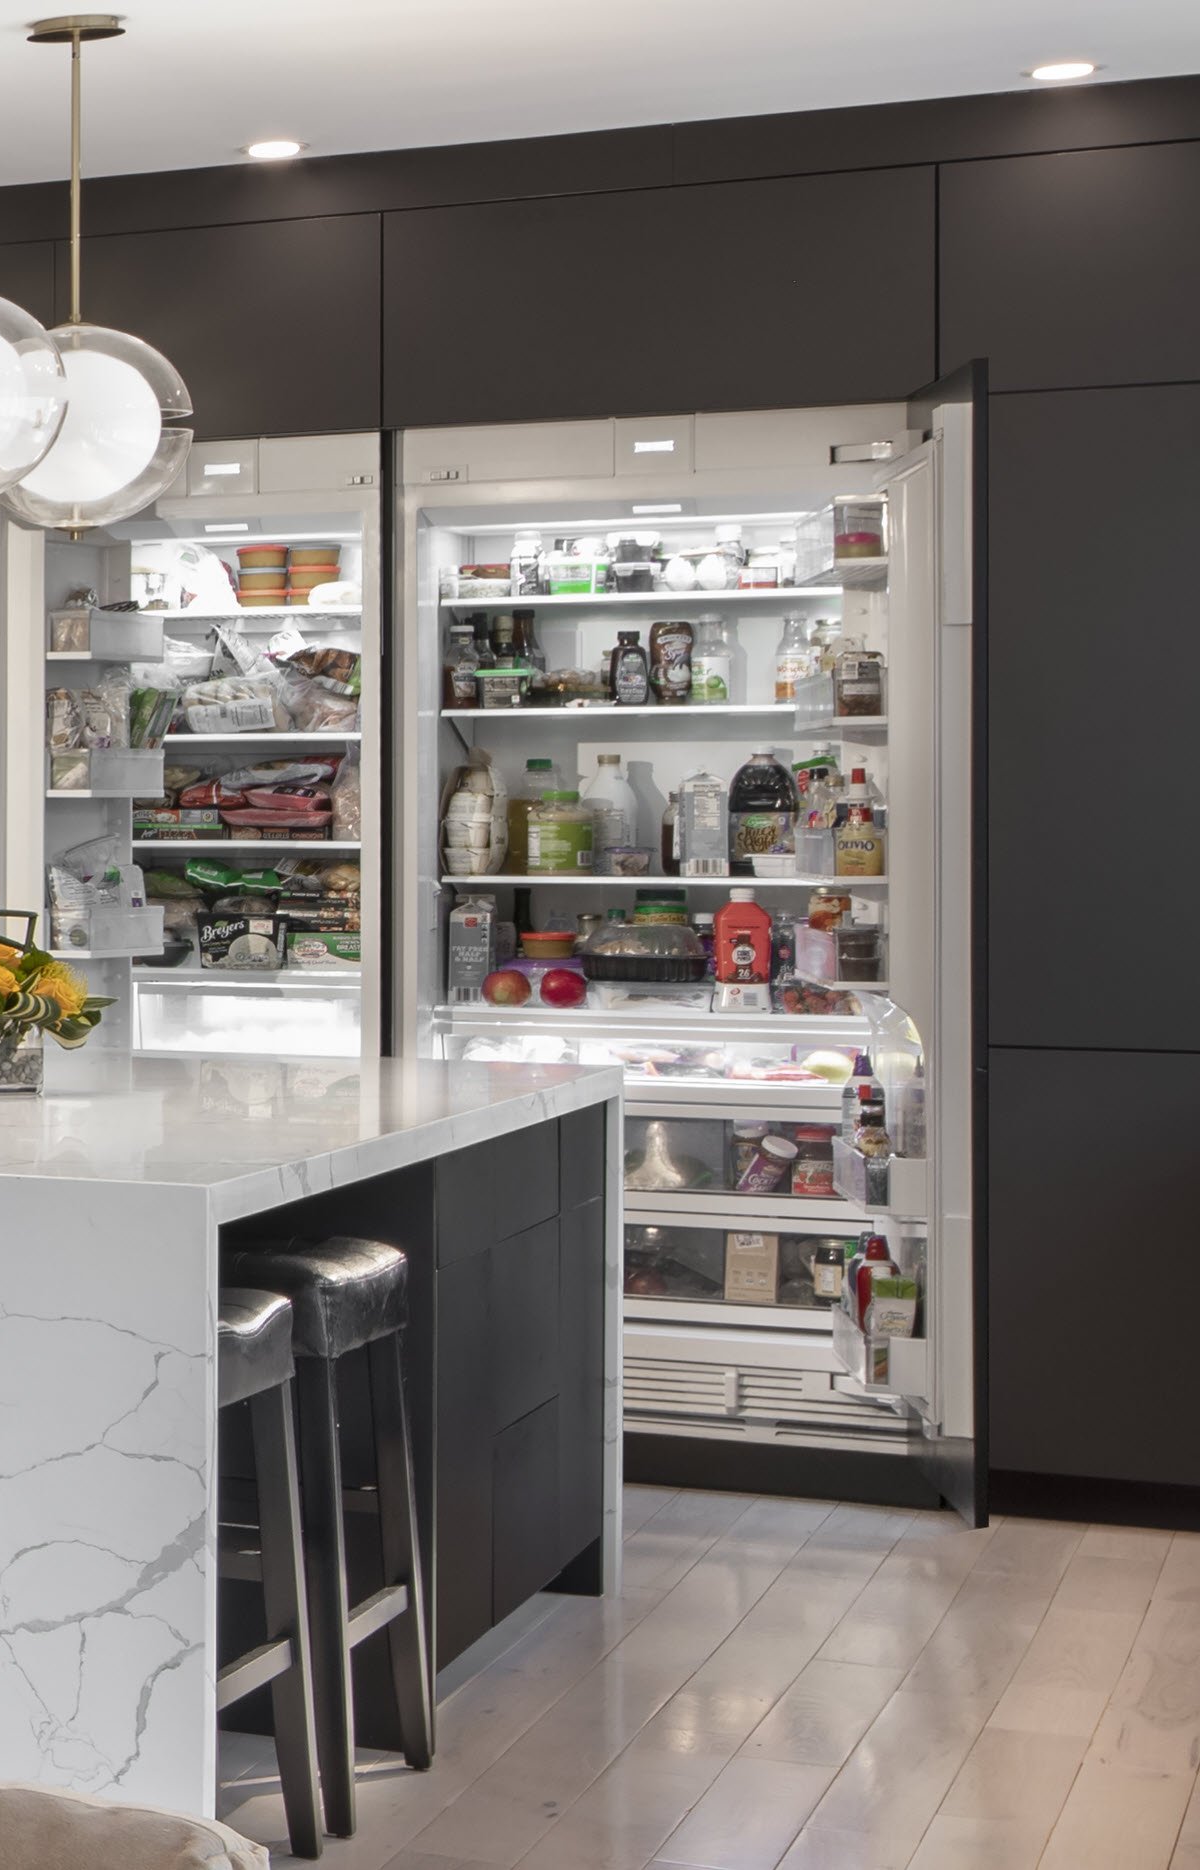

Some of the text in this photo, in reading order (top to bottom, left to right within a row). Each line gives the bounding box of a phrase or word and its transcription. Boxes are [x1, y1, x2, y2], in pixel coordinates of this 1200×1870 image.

[838, 840, 875, 851] OLIVIO
[201, 920, 245, 943] Breyers
[738, 968, 751, 977] 26
